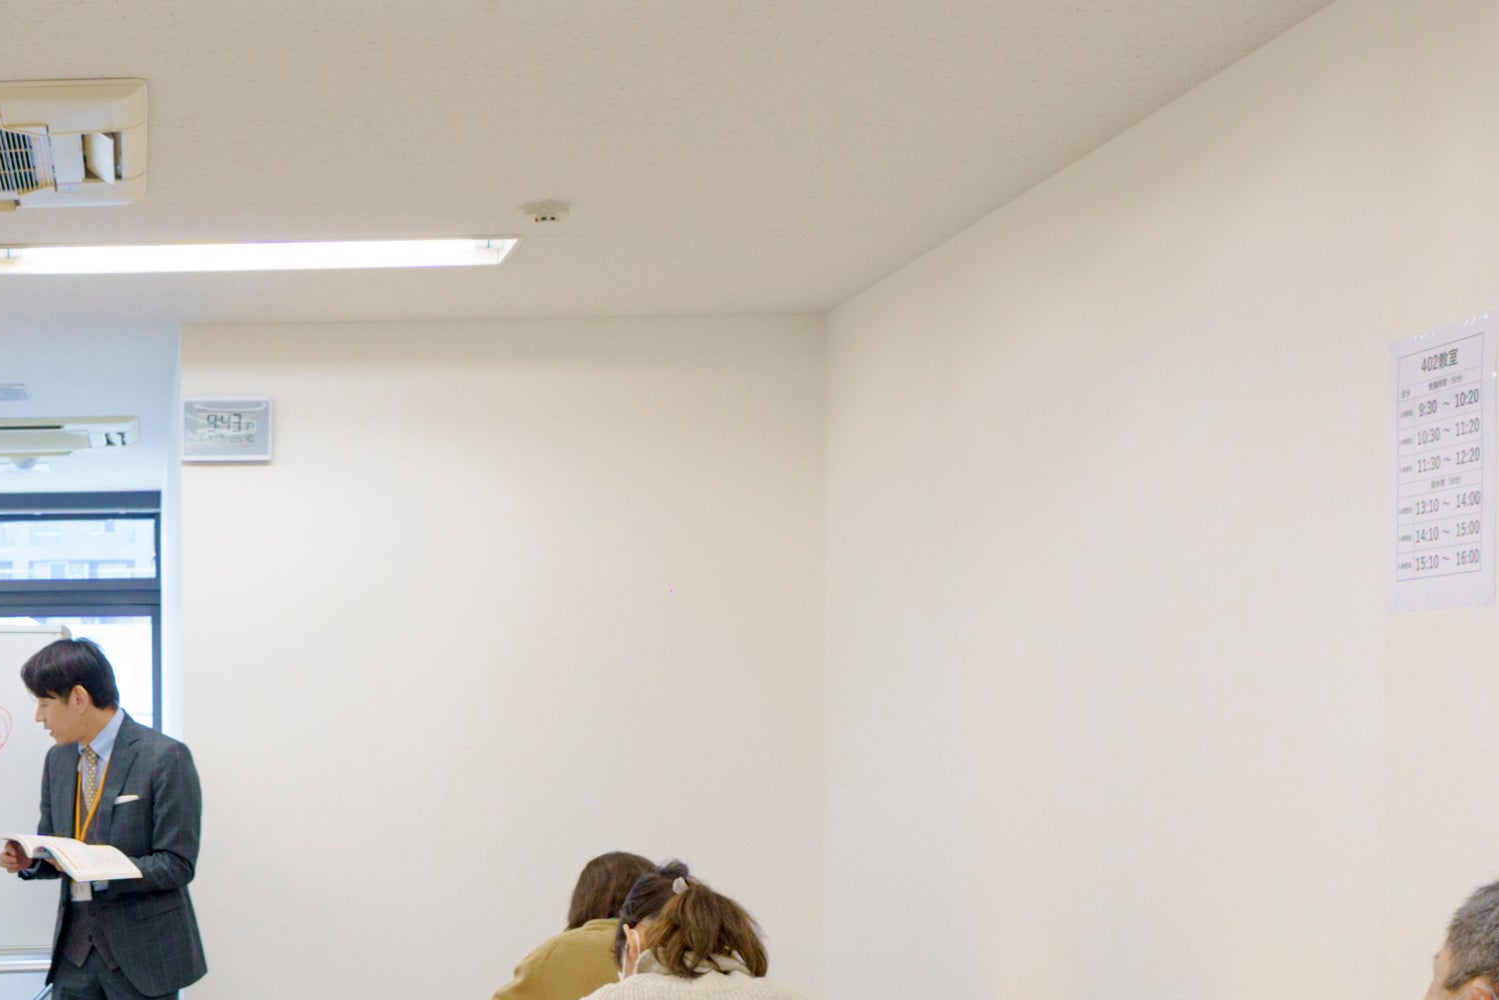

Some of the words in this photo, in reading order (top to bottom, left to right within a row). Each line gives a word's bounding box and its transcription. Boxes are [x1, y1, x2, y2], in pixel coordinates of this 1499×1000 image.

[1420, 348, 1459, 372] 402教室
[1418, 399, 1438, 417] 9:30
[1455, 388, 1480, 408] 10:20
[1417, 427, 1441, 446] 10:30
[1455, 417, 1480, 437] 11:20
[1417, 455, 1441, 474] 11:30
[1455, 447, 1481, 465] 12:20
[1416, 498, 1439, 516] 13:10
[1456, 490, 1481, 508] 14:00
[1415, 526, 1439, 544] 14:10
[1456, 520, 1480, 537] 15:00
[1415, 554, 1439, 571] 15:10
[1456, 548, 1480, 566] 16:00
